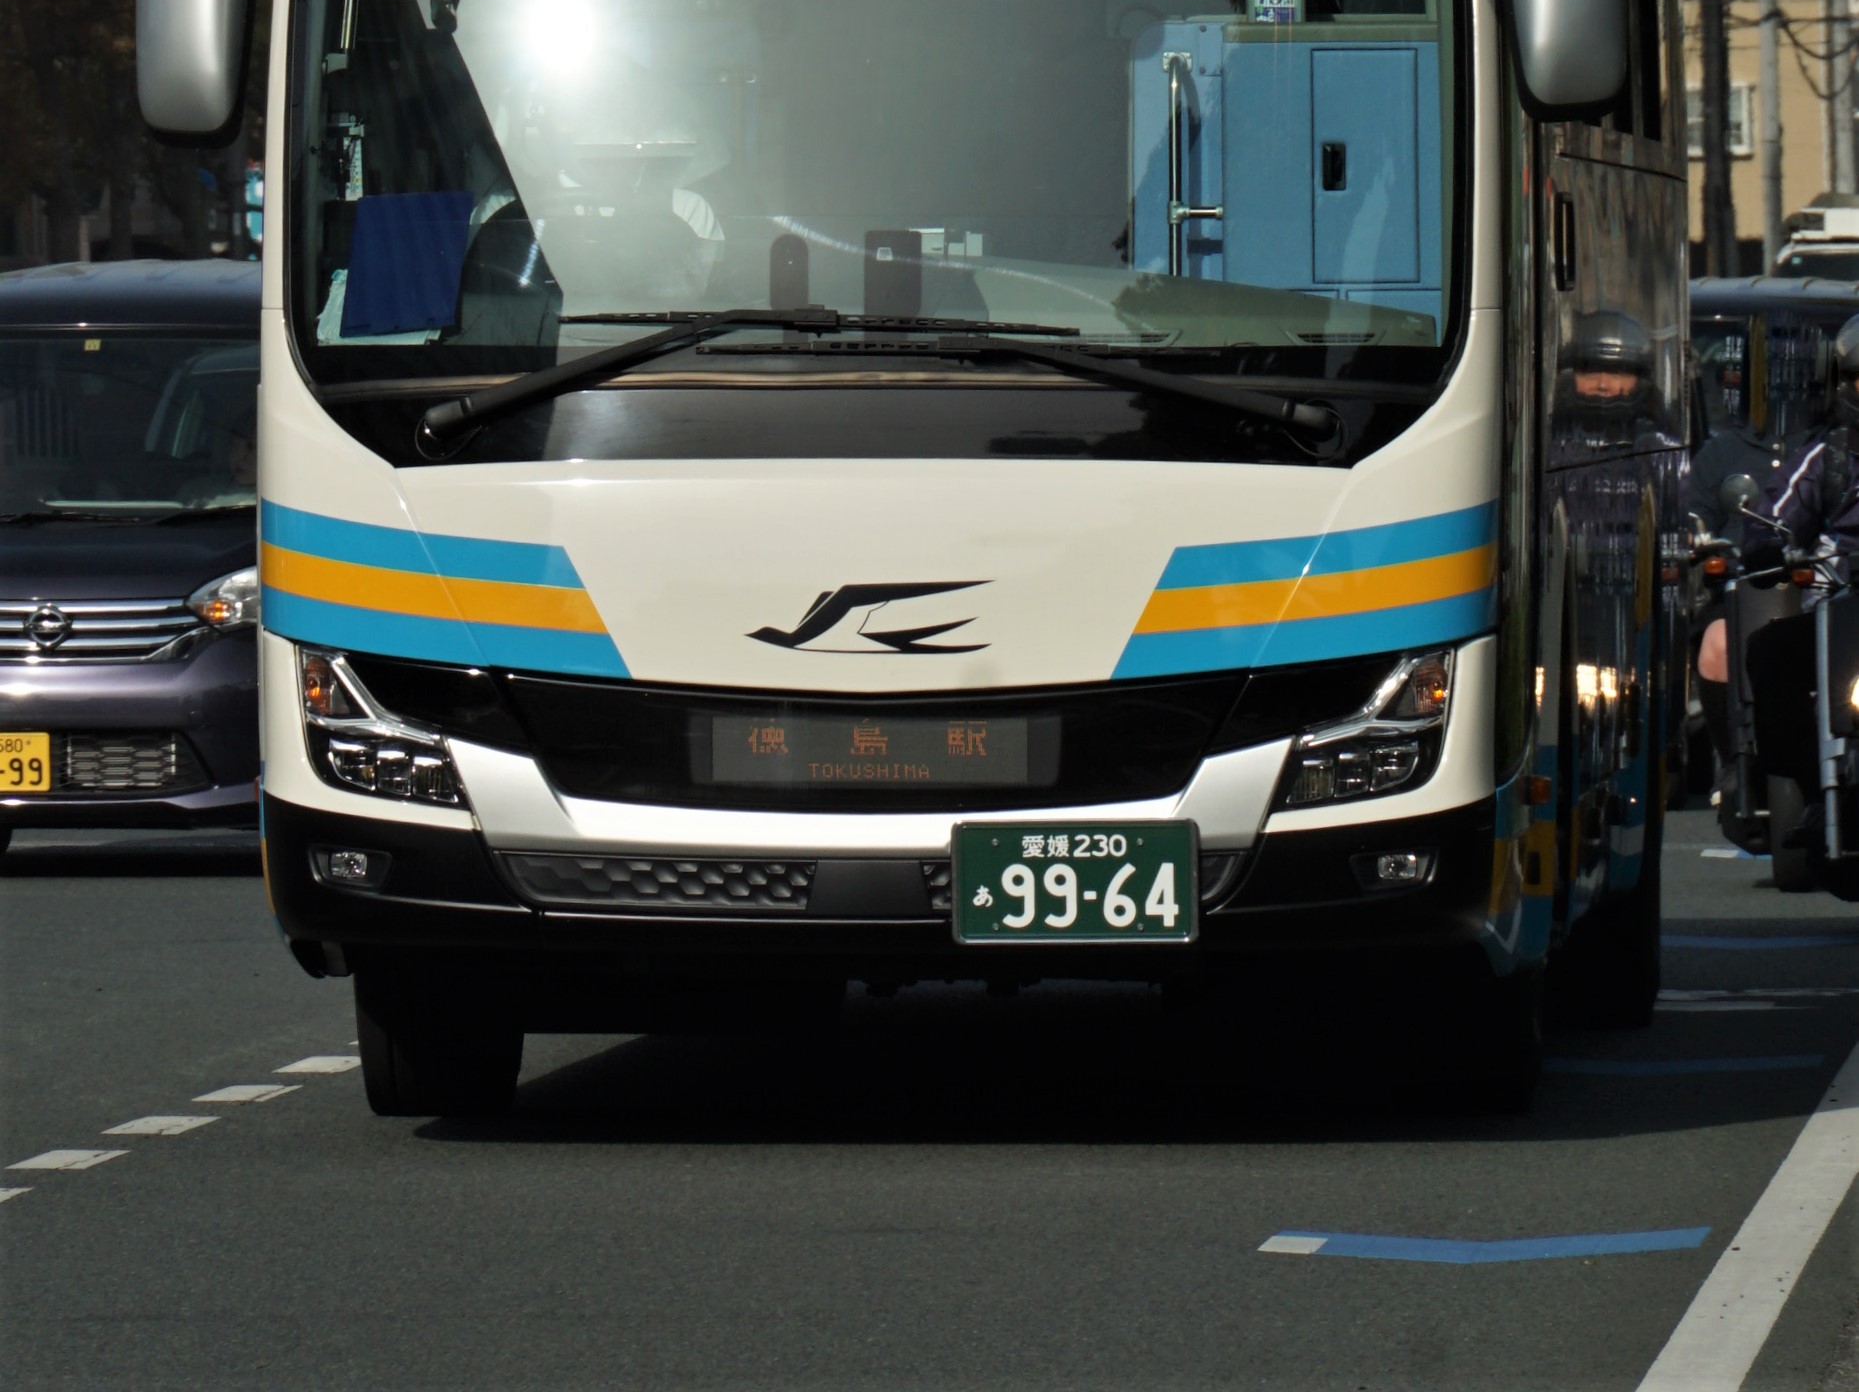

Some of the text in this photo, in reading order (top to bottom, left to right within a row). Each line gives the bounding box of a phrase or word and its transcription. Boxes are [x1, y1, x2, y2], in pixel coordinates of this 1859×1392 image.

[808, 763, 931, 780] TOKUSHIMA
[972, 862, 1180, 928] あ 99-64
